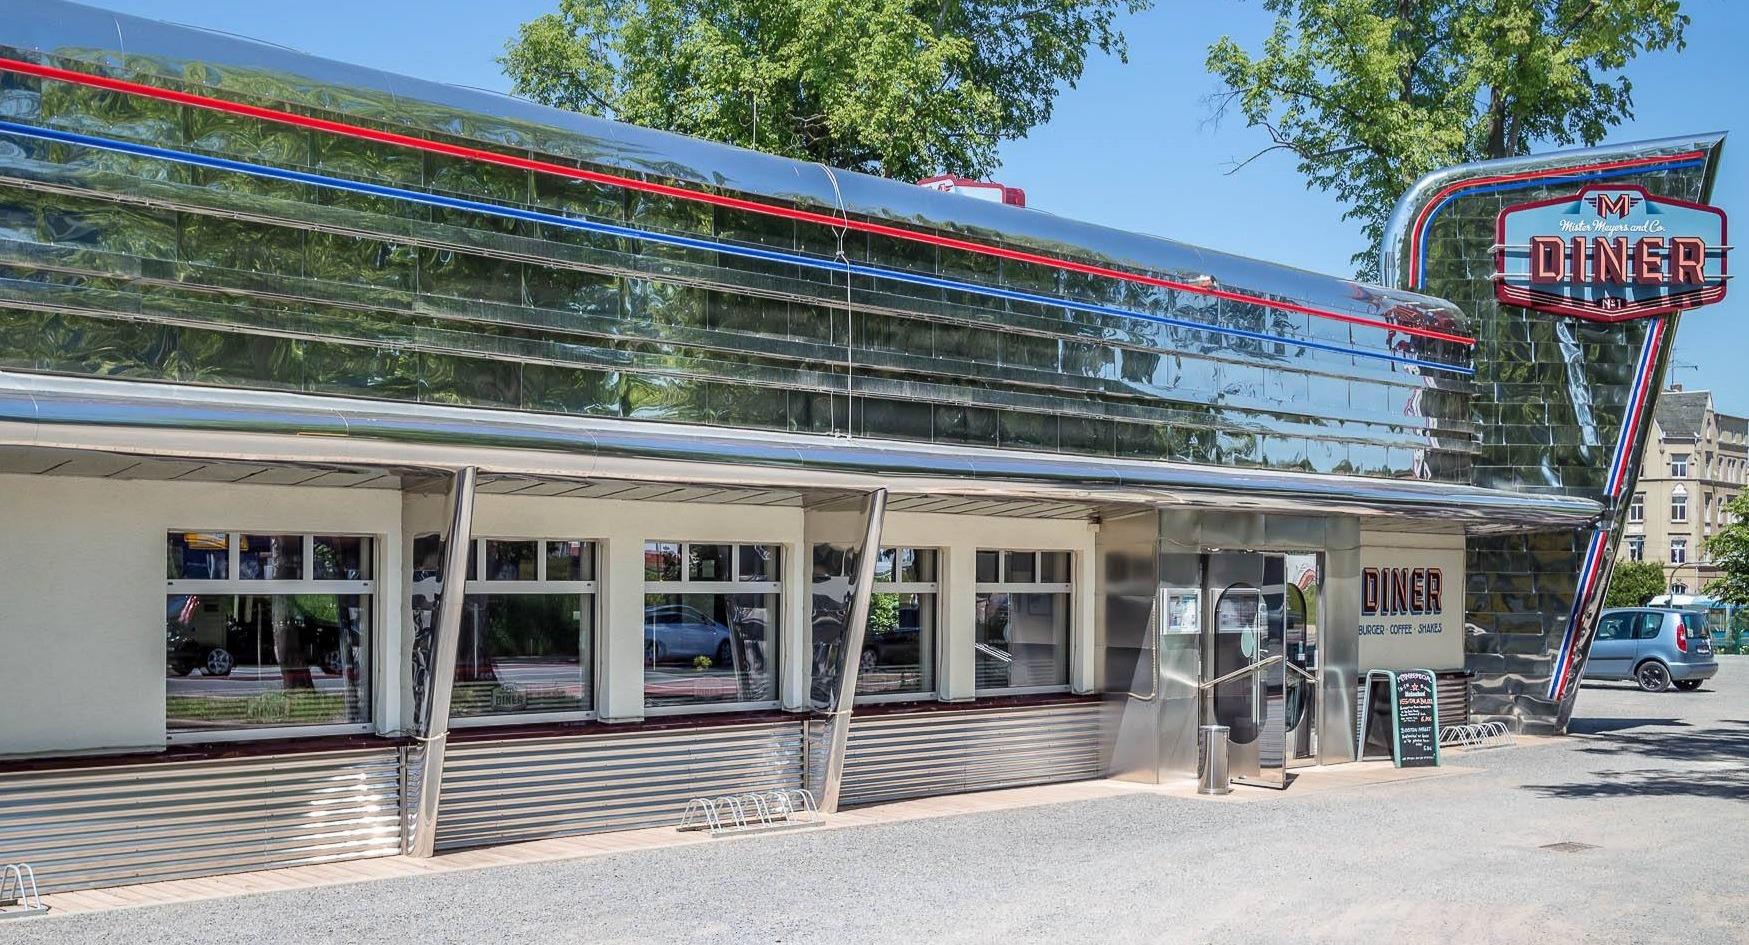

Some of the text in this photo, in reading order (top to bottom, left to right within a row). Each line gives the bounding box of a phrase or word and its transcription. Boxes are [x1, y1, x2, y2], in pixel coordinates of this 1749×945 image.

[1560, 219, 1666, 237] Mister Meyers and Co.
[1529, 236, 1706, 285] DINER
[1361, 567, 1443, 616] DINER
[1358, 622, 1443, 636] BURGER COFFEE SHAKES
